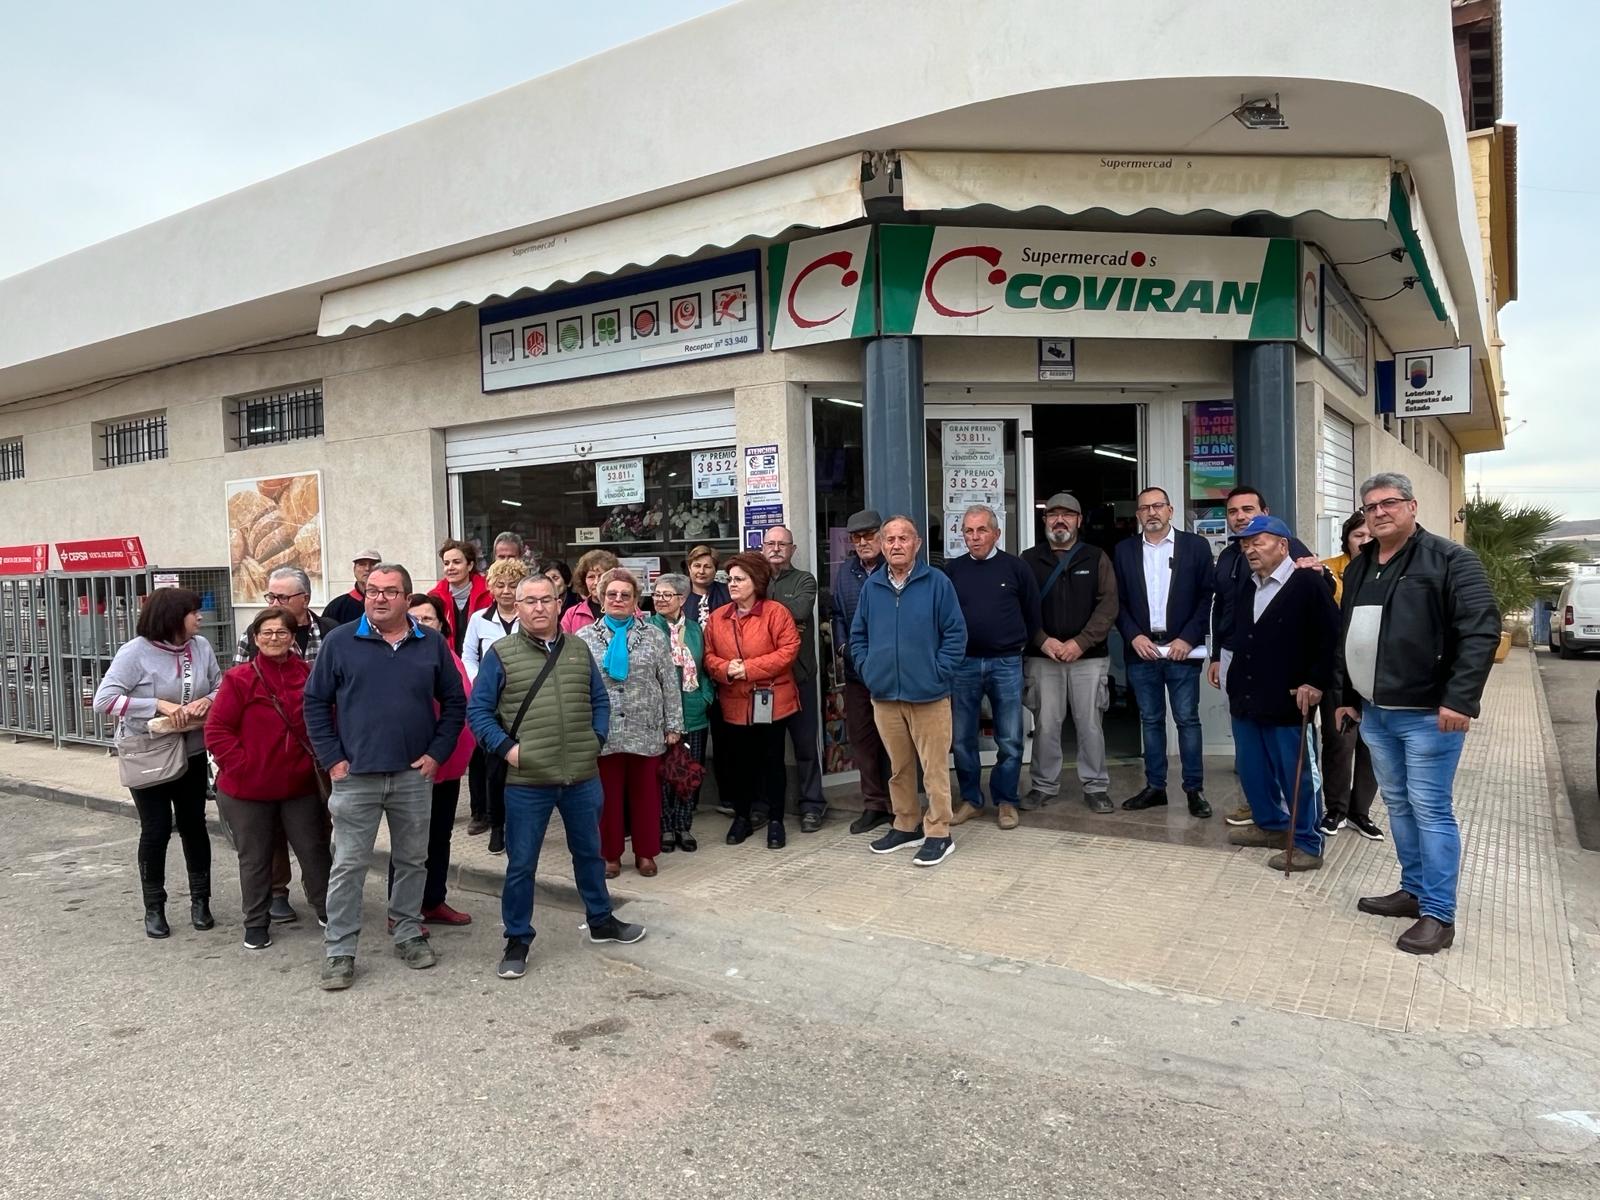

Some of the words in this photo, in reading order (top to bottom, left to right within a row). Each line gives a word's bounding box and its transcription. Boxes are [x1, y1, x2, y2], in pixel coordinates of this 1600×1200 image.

[1100, 157, 1192, 170] Supermercads
[1005, 273, 1259, 315] COVIRAN
[684, 342, 714, 352] Receptor
[724, 335, 748, 347] 53.940
[1406, 397, 1439, 405] Apuestas
[1405, 404, 1430, 412] Estado
[1194, 445, 1209, 455] 30
[709, 451, 737, 460] PREMIO
[601, 464, 619, 472] GRAN
[619, 462, 638, 470] PREMIO
[964, 469, 995, 477] PREMIO
[950, 478, 999, 489] 38524
